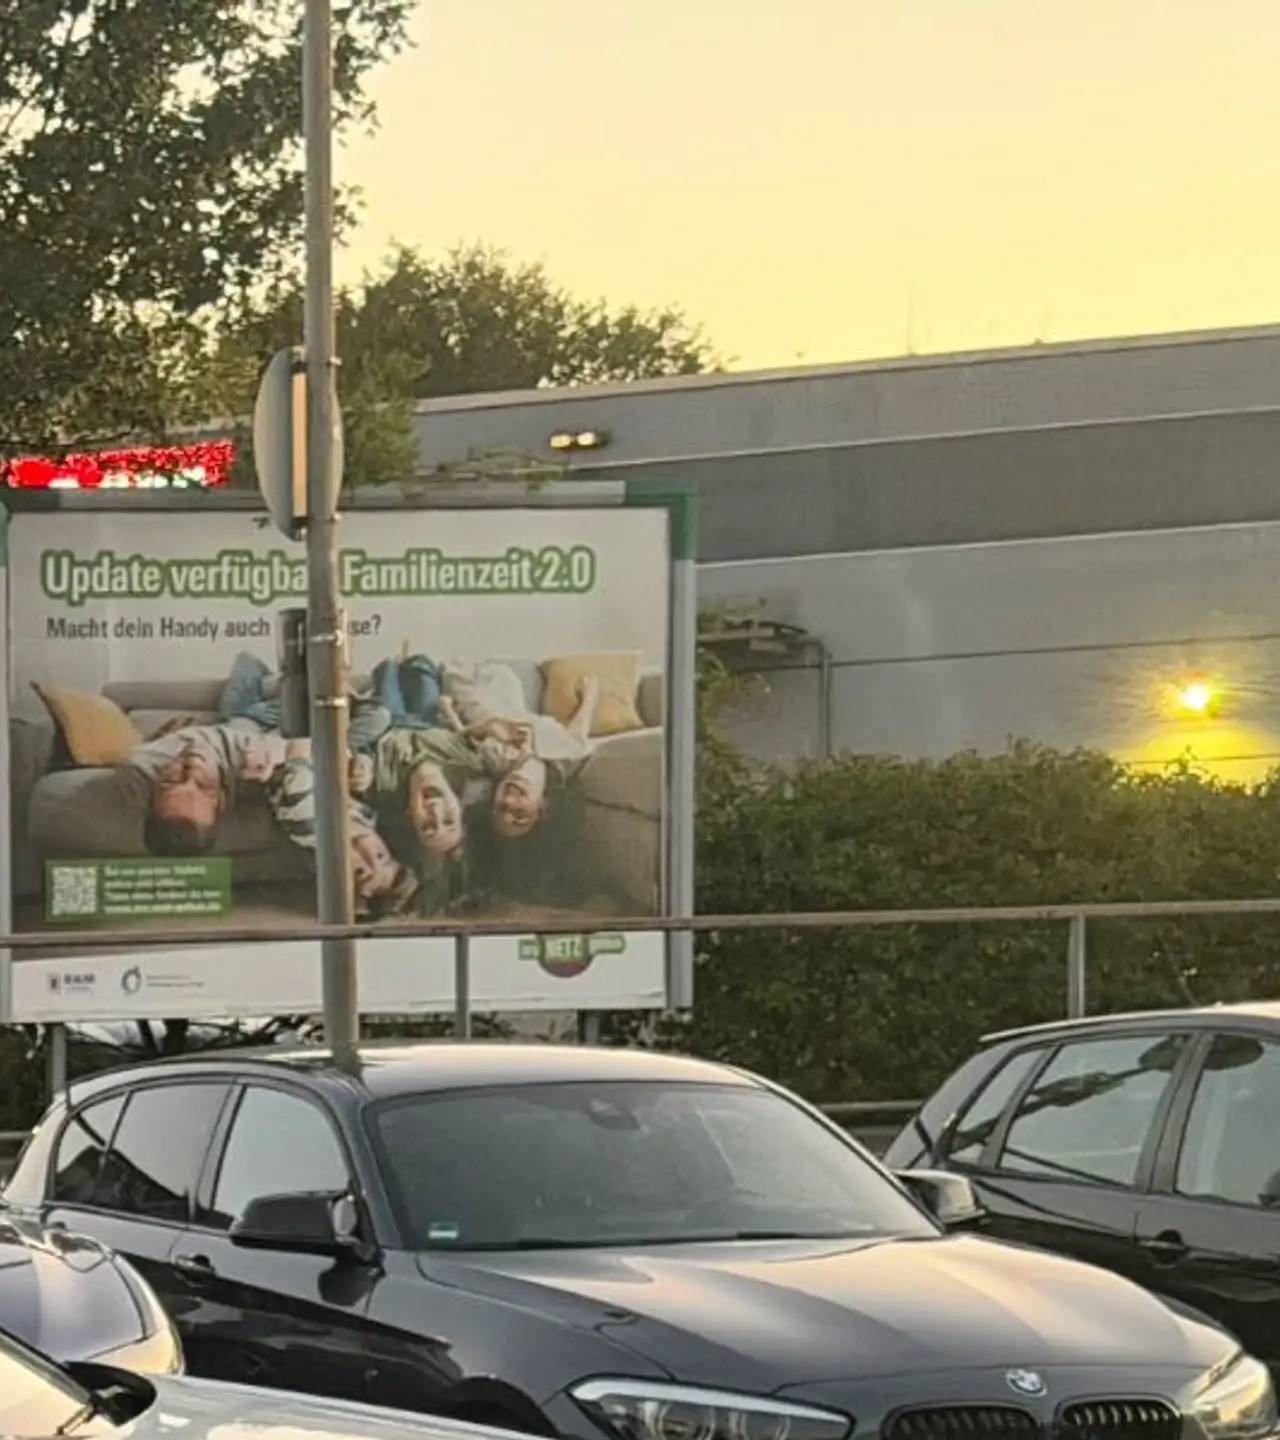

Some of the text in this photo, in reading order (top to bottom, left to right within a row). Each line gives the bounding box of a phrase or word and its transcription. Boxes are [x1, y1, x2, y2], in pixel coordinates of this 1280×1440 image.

[45, 555, 162, 602] Update
[342, 551, 533, 592] Familienzeit
[540, 550, 592, 588] 2.0
[46, 616, 108, 638] Macht
[114, 617, 153, 637] dein
[160, 617, 219, 642] Handy
[224, 617, 270, 638] auch
